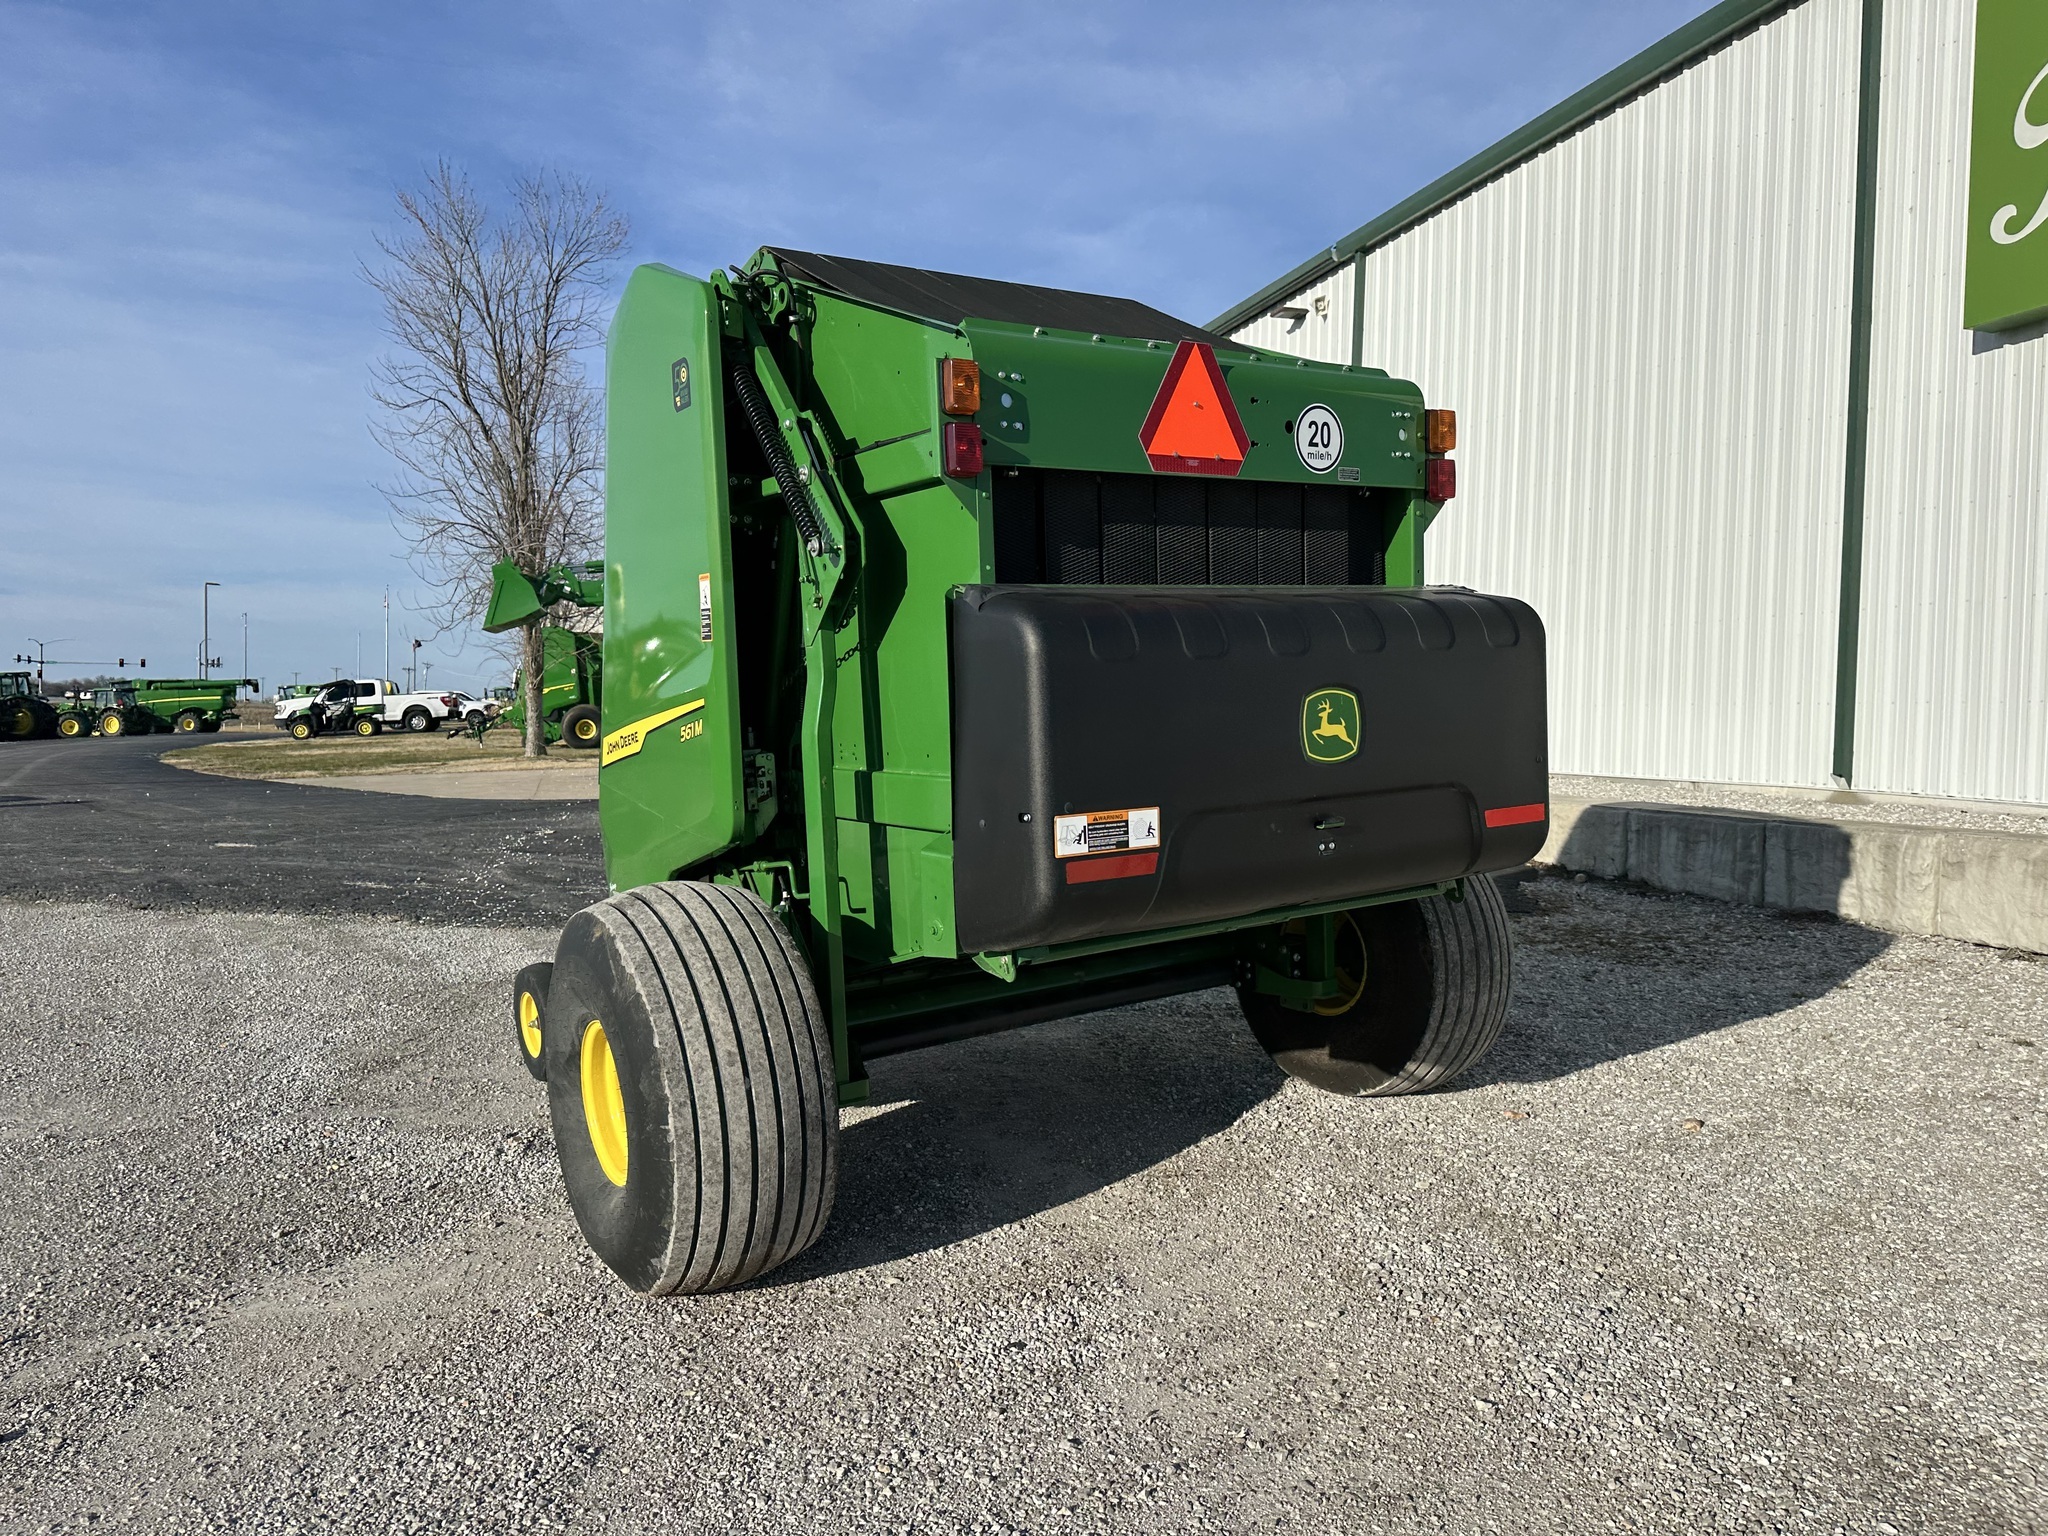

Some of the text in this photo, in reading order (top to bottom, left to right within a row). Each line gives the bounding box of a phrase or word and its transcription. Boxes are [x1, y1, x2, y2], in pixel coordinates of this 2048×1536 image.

[1308, 420, 1331, 449] 20
[1307, 450, 1332, 461] mile/h
[606, 731, 639, 755] JOHN DEERE
[680, 719, 703, 743] 561M
